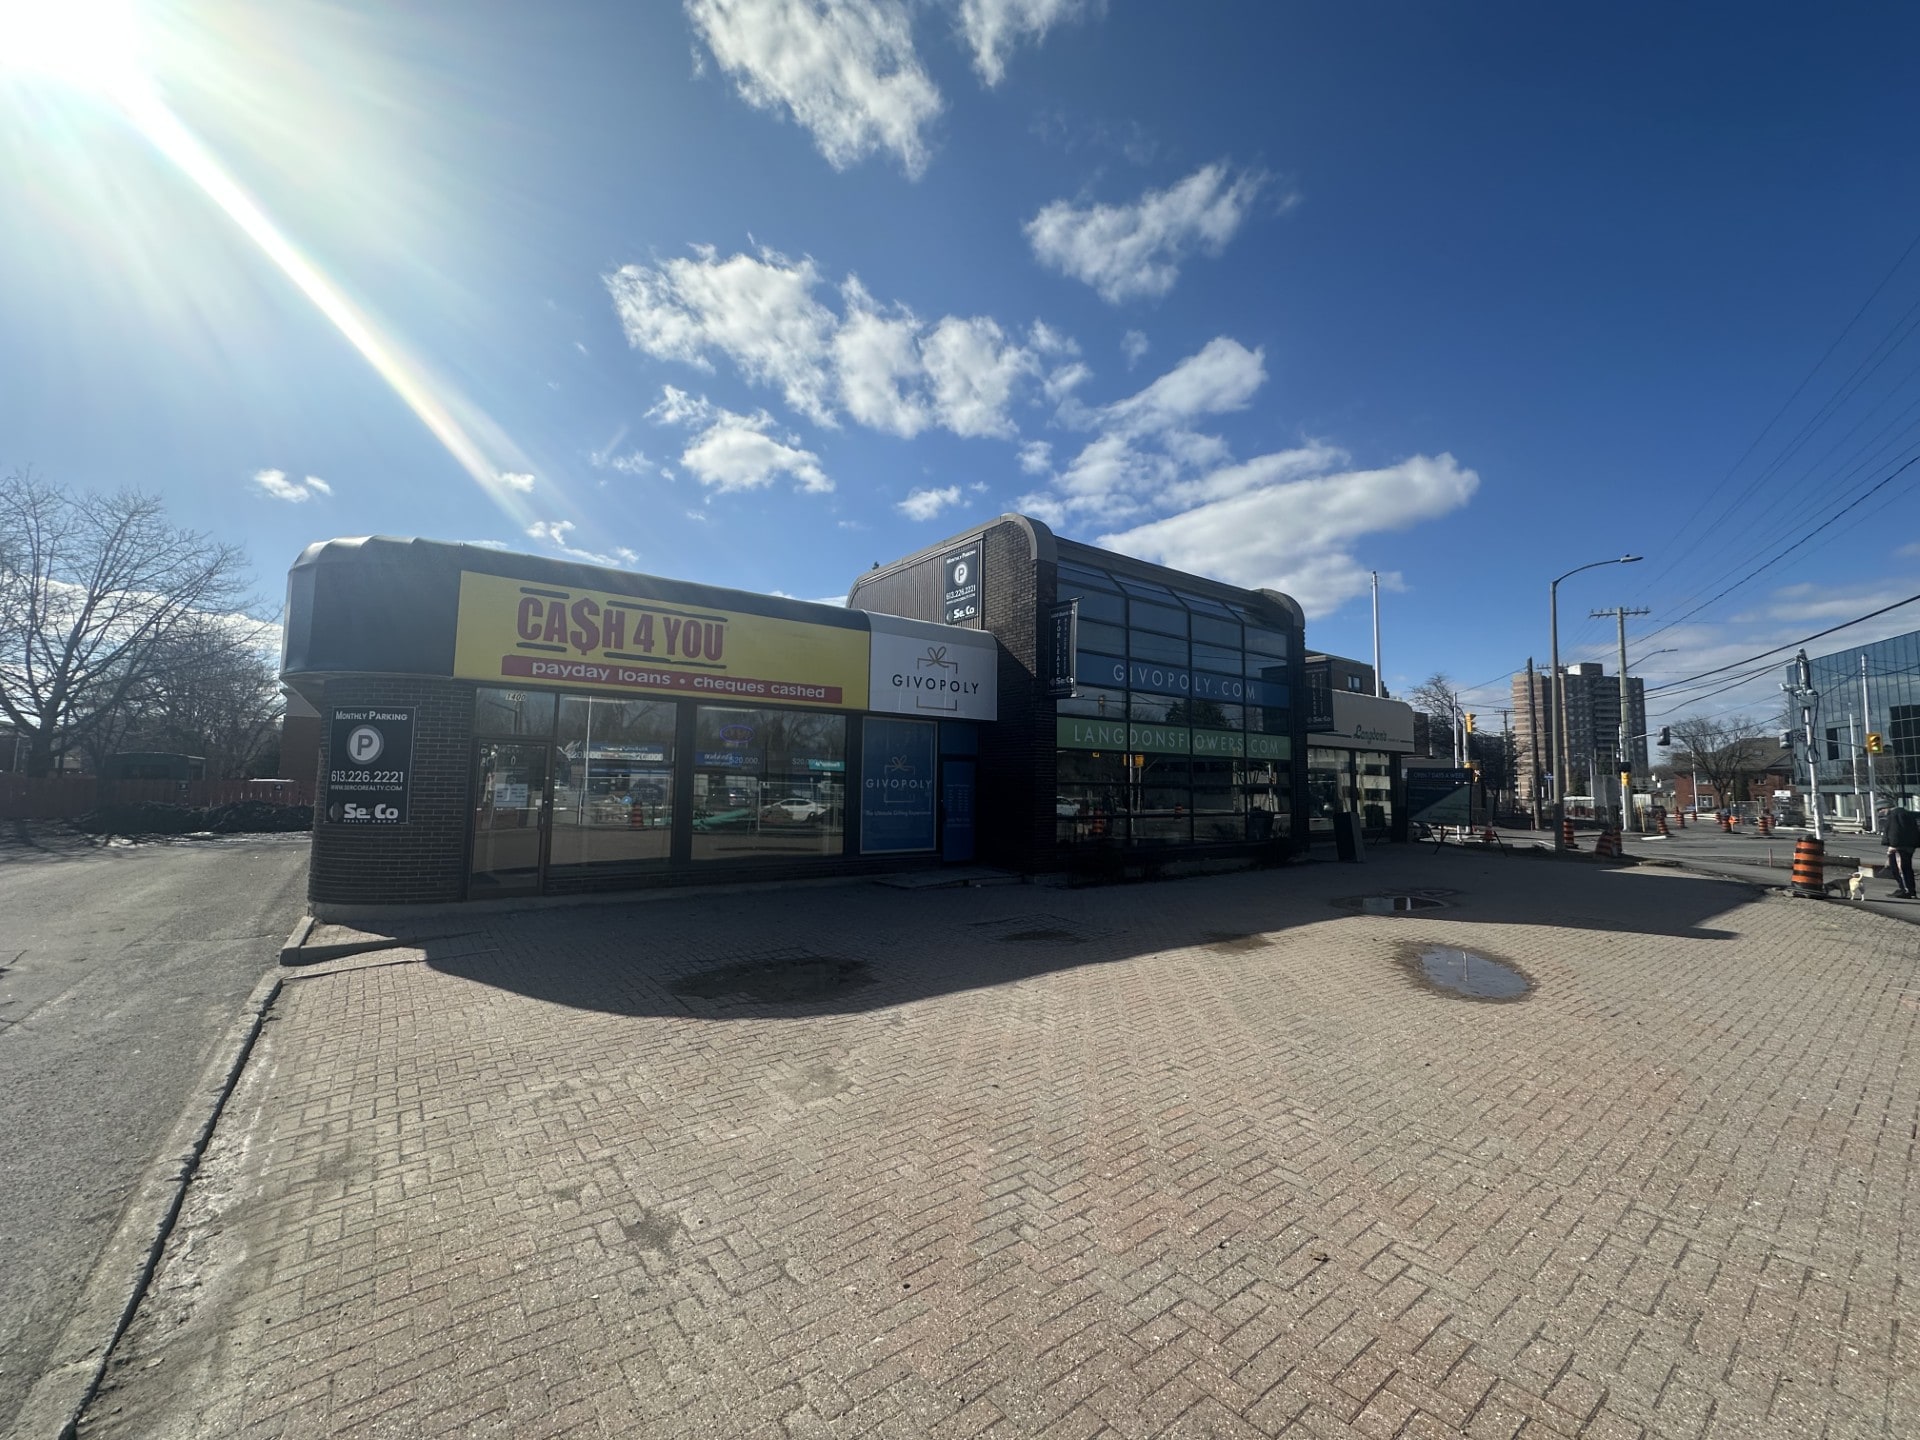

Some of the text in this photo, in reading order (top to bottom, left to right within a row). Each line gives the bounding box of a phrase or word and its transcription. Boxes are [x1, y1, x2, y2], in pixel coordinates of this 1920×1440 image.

[517, 596, 724, 661] CA$H 4 YOU
[531, 660, 826, 700] payday loans cheques cashed
[891, 673, 980, 695] GIVOPOLY
[1112, 664, 1256, 700] GIVOPOLY.COM
[368, 710, 409, 721] PARKING
[356, 734, 374, 756] P
[330, 770, 404, 783] 613.226.2221
[865, 778, 932, 789] GIVOPOLY
